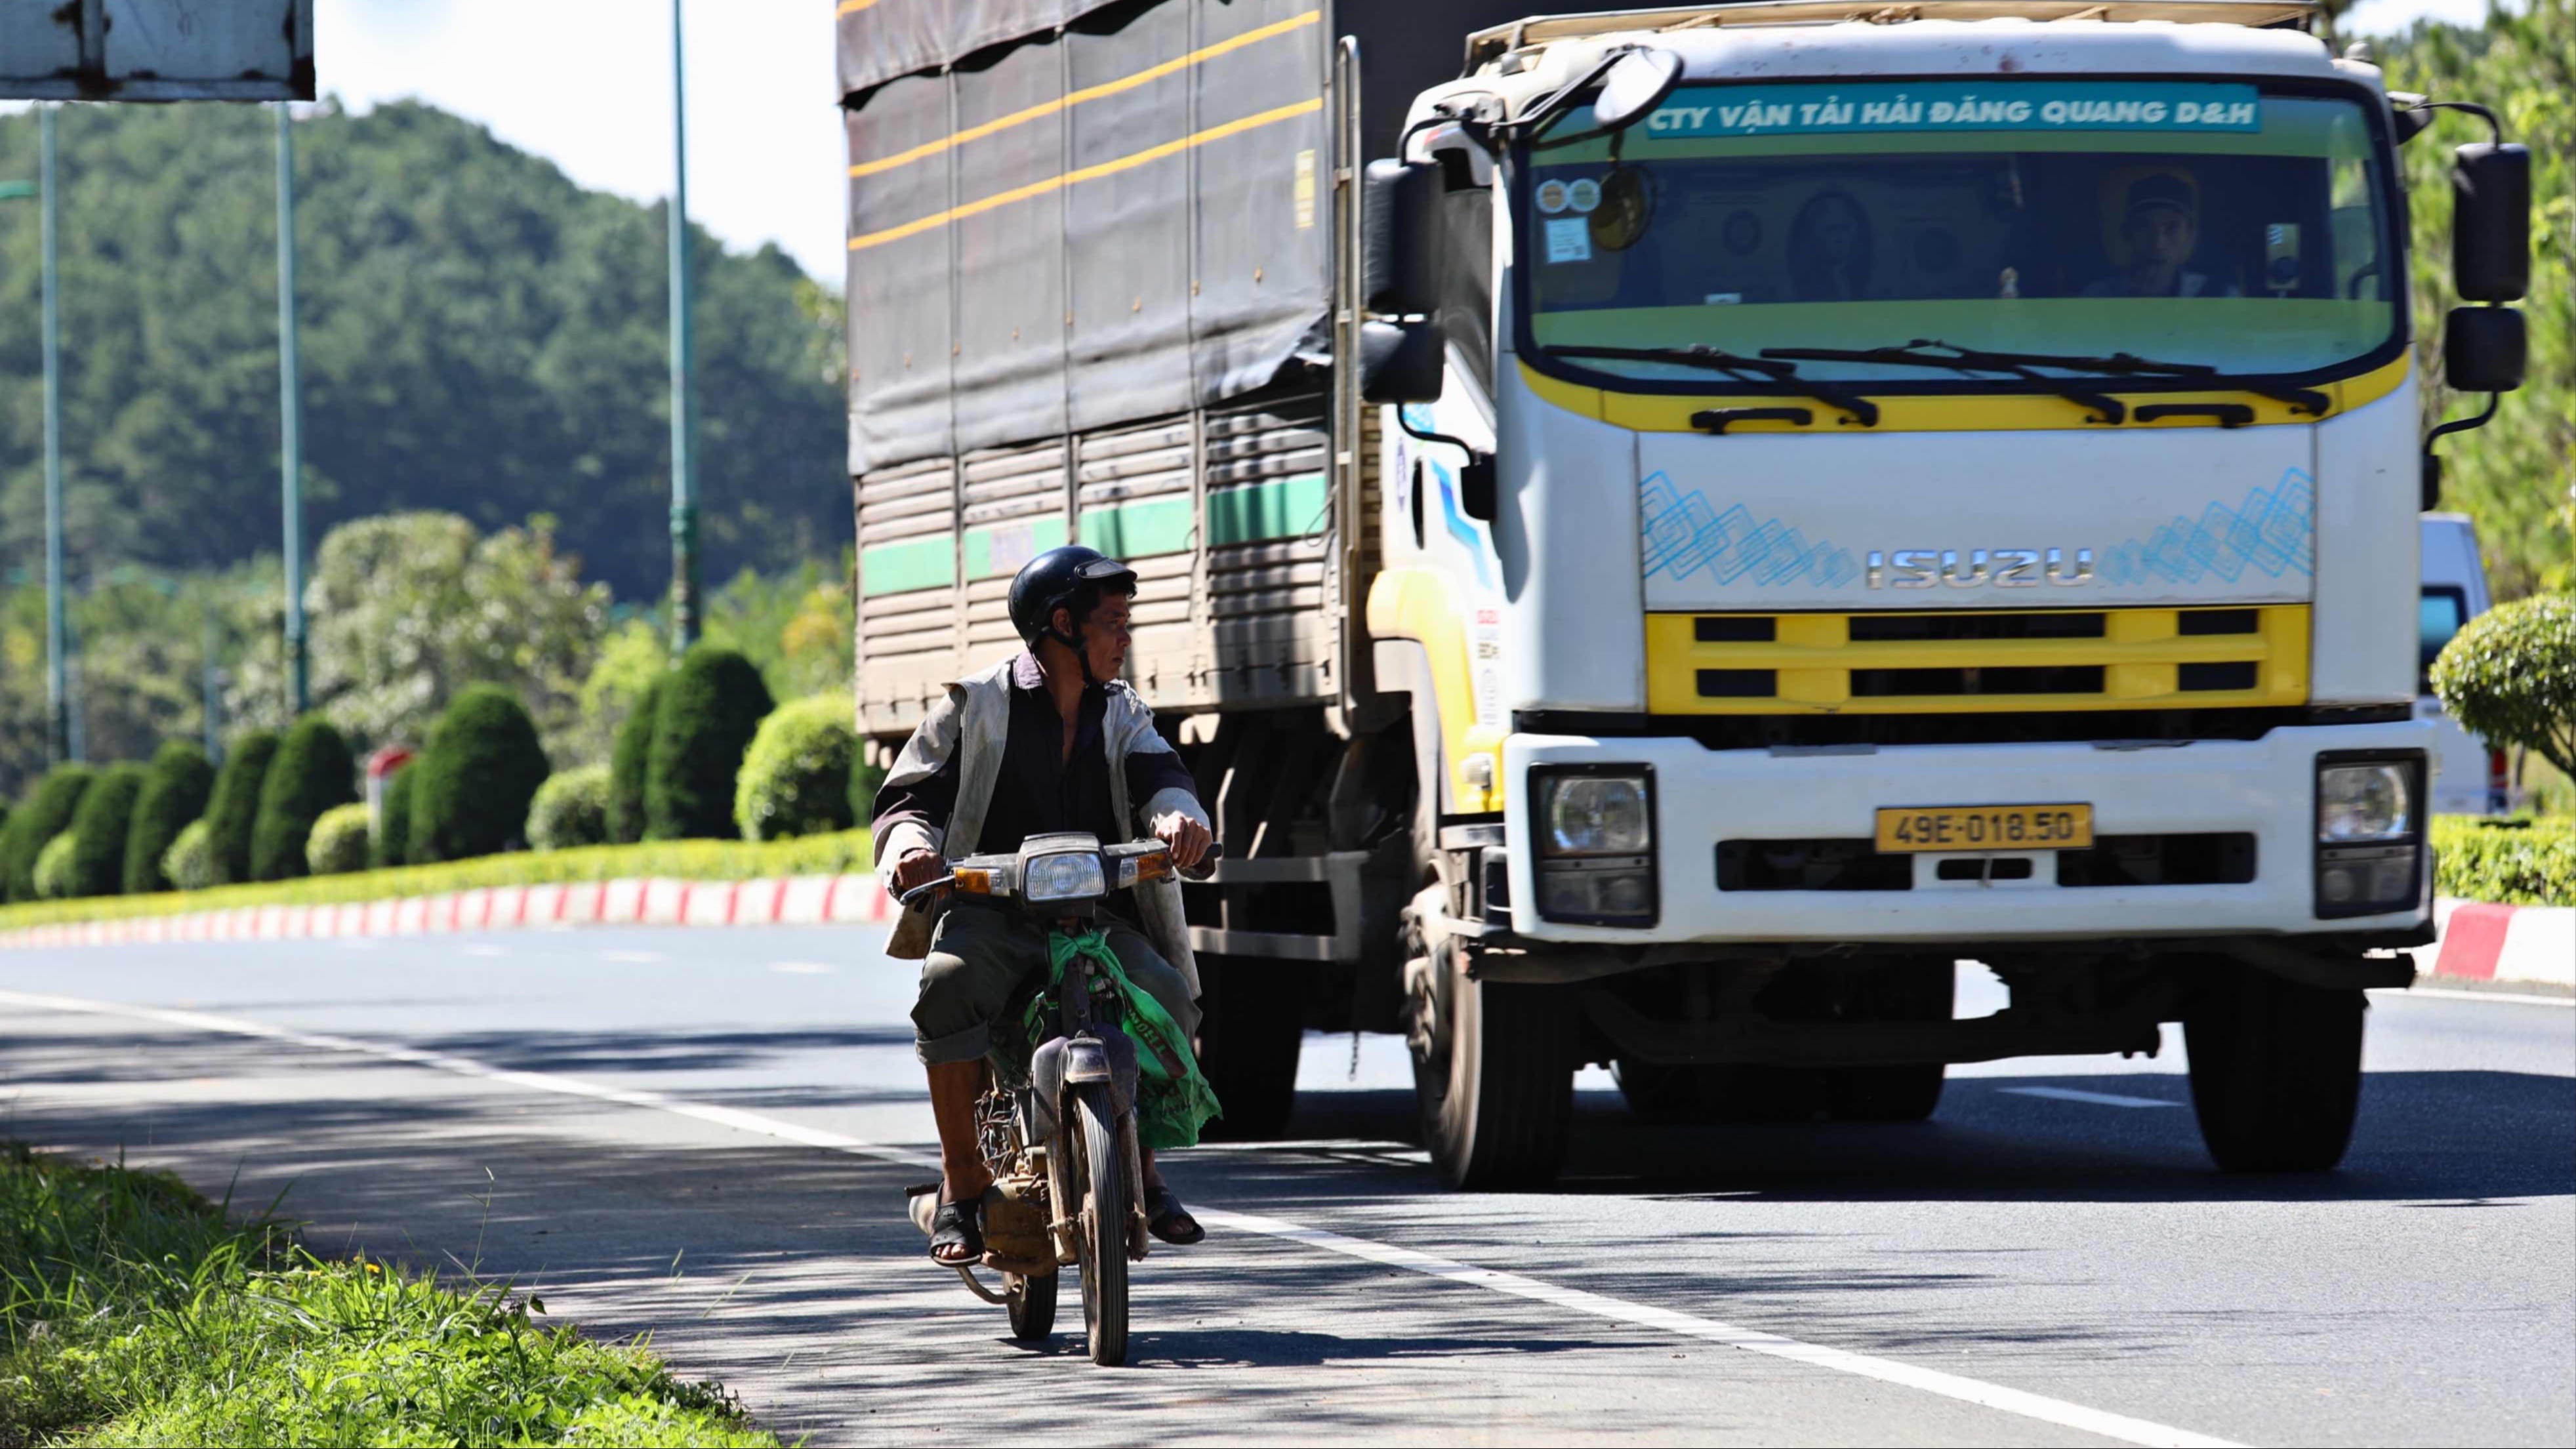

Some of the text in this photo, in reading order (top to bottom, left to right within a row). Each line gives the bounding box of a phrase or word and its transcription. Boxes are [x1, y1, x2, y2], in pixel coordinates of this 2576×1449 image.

[1648, 107, 1711, 131] CTY
[1719, 99, 1793, 134] VẬN
[1799, 95, 1854, 125] TẢI
[1860, 94, 1923, 124] HẢI
[2040, 100, 2167, 125] QUANG
[2174, 102, 2257, 125] D&H
[1867, 548, 2093, 589] ISUZU
[1895, 811, 2074, 844] 49E-018.50
